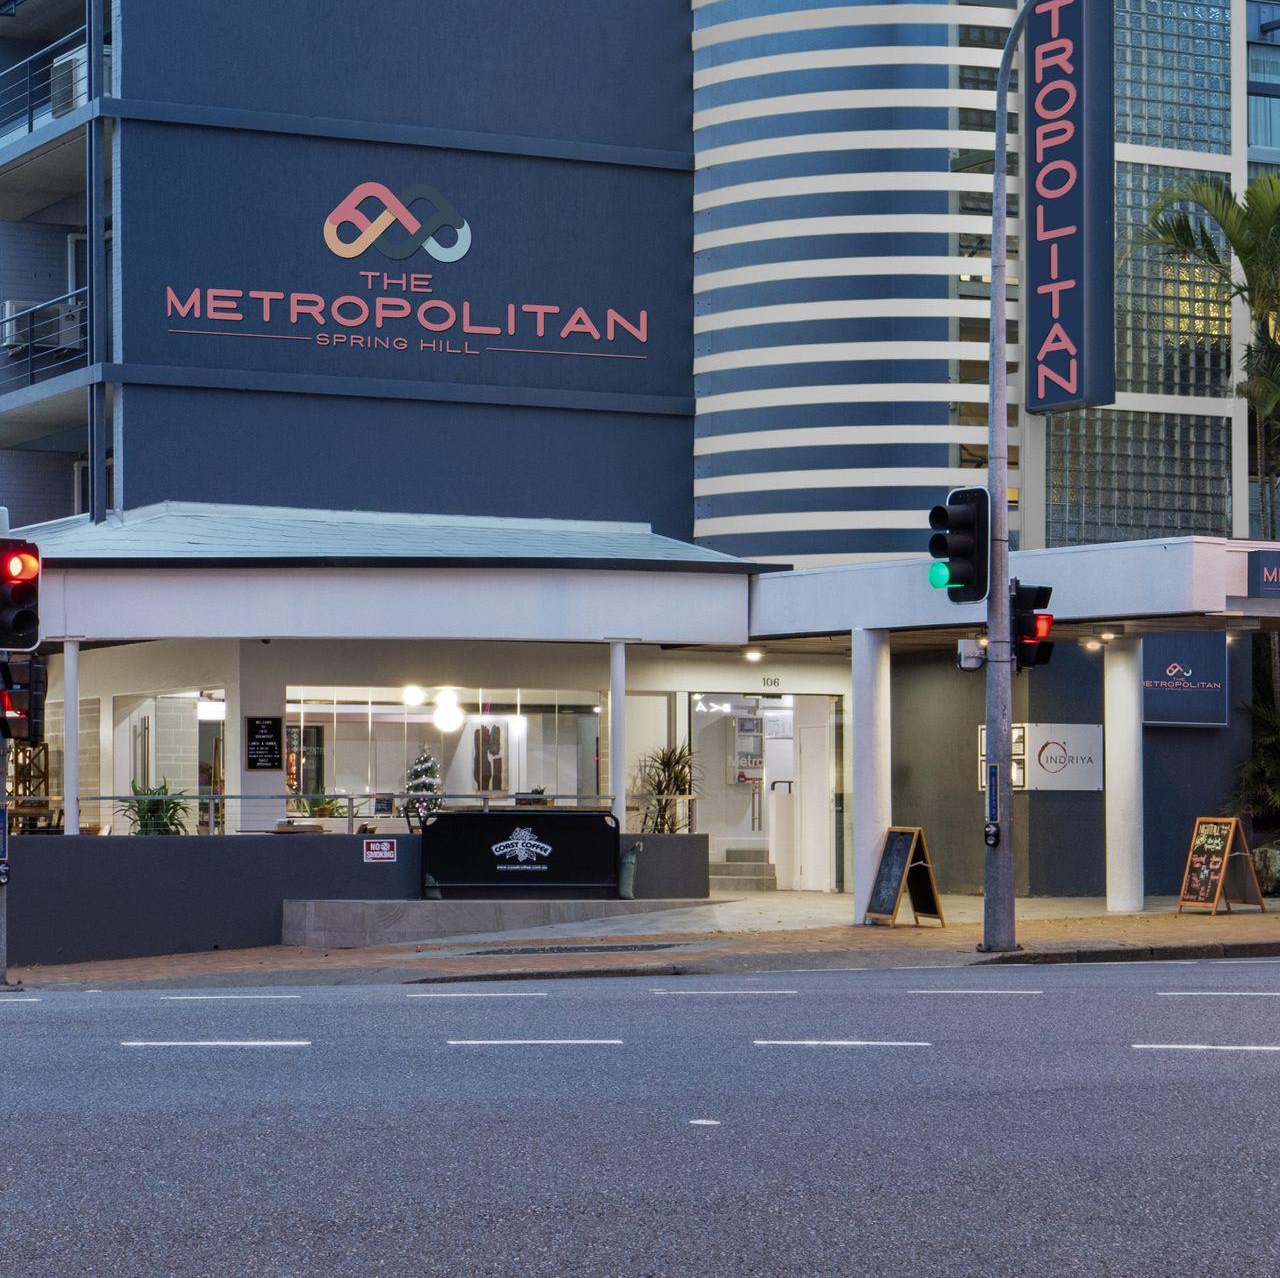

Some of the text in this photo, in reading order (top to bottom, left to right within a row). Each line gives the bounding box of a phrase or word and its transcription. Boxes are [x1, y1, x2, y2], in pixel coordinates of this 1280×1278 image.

[359, 271, 433, 293] THE
[166, 285, 648, 343] METROPOLITAN
[315, 333, 481, 355] SPRING HILL
[762, 677, 780, 687] 106
[1045, 755, 1094, 765] INDRIYA
[370, 843, 380, 851] NO
[494, 841, 549, 853] COAST COFFEE
[366, 851, 394, 859] SMOKING
